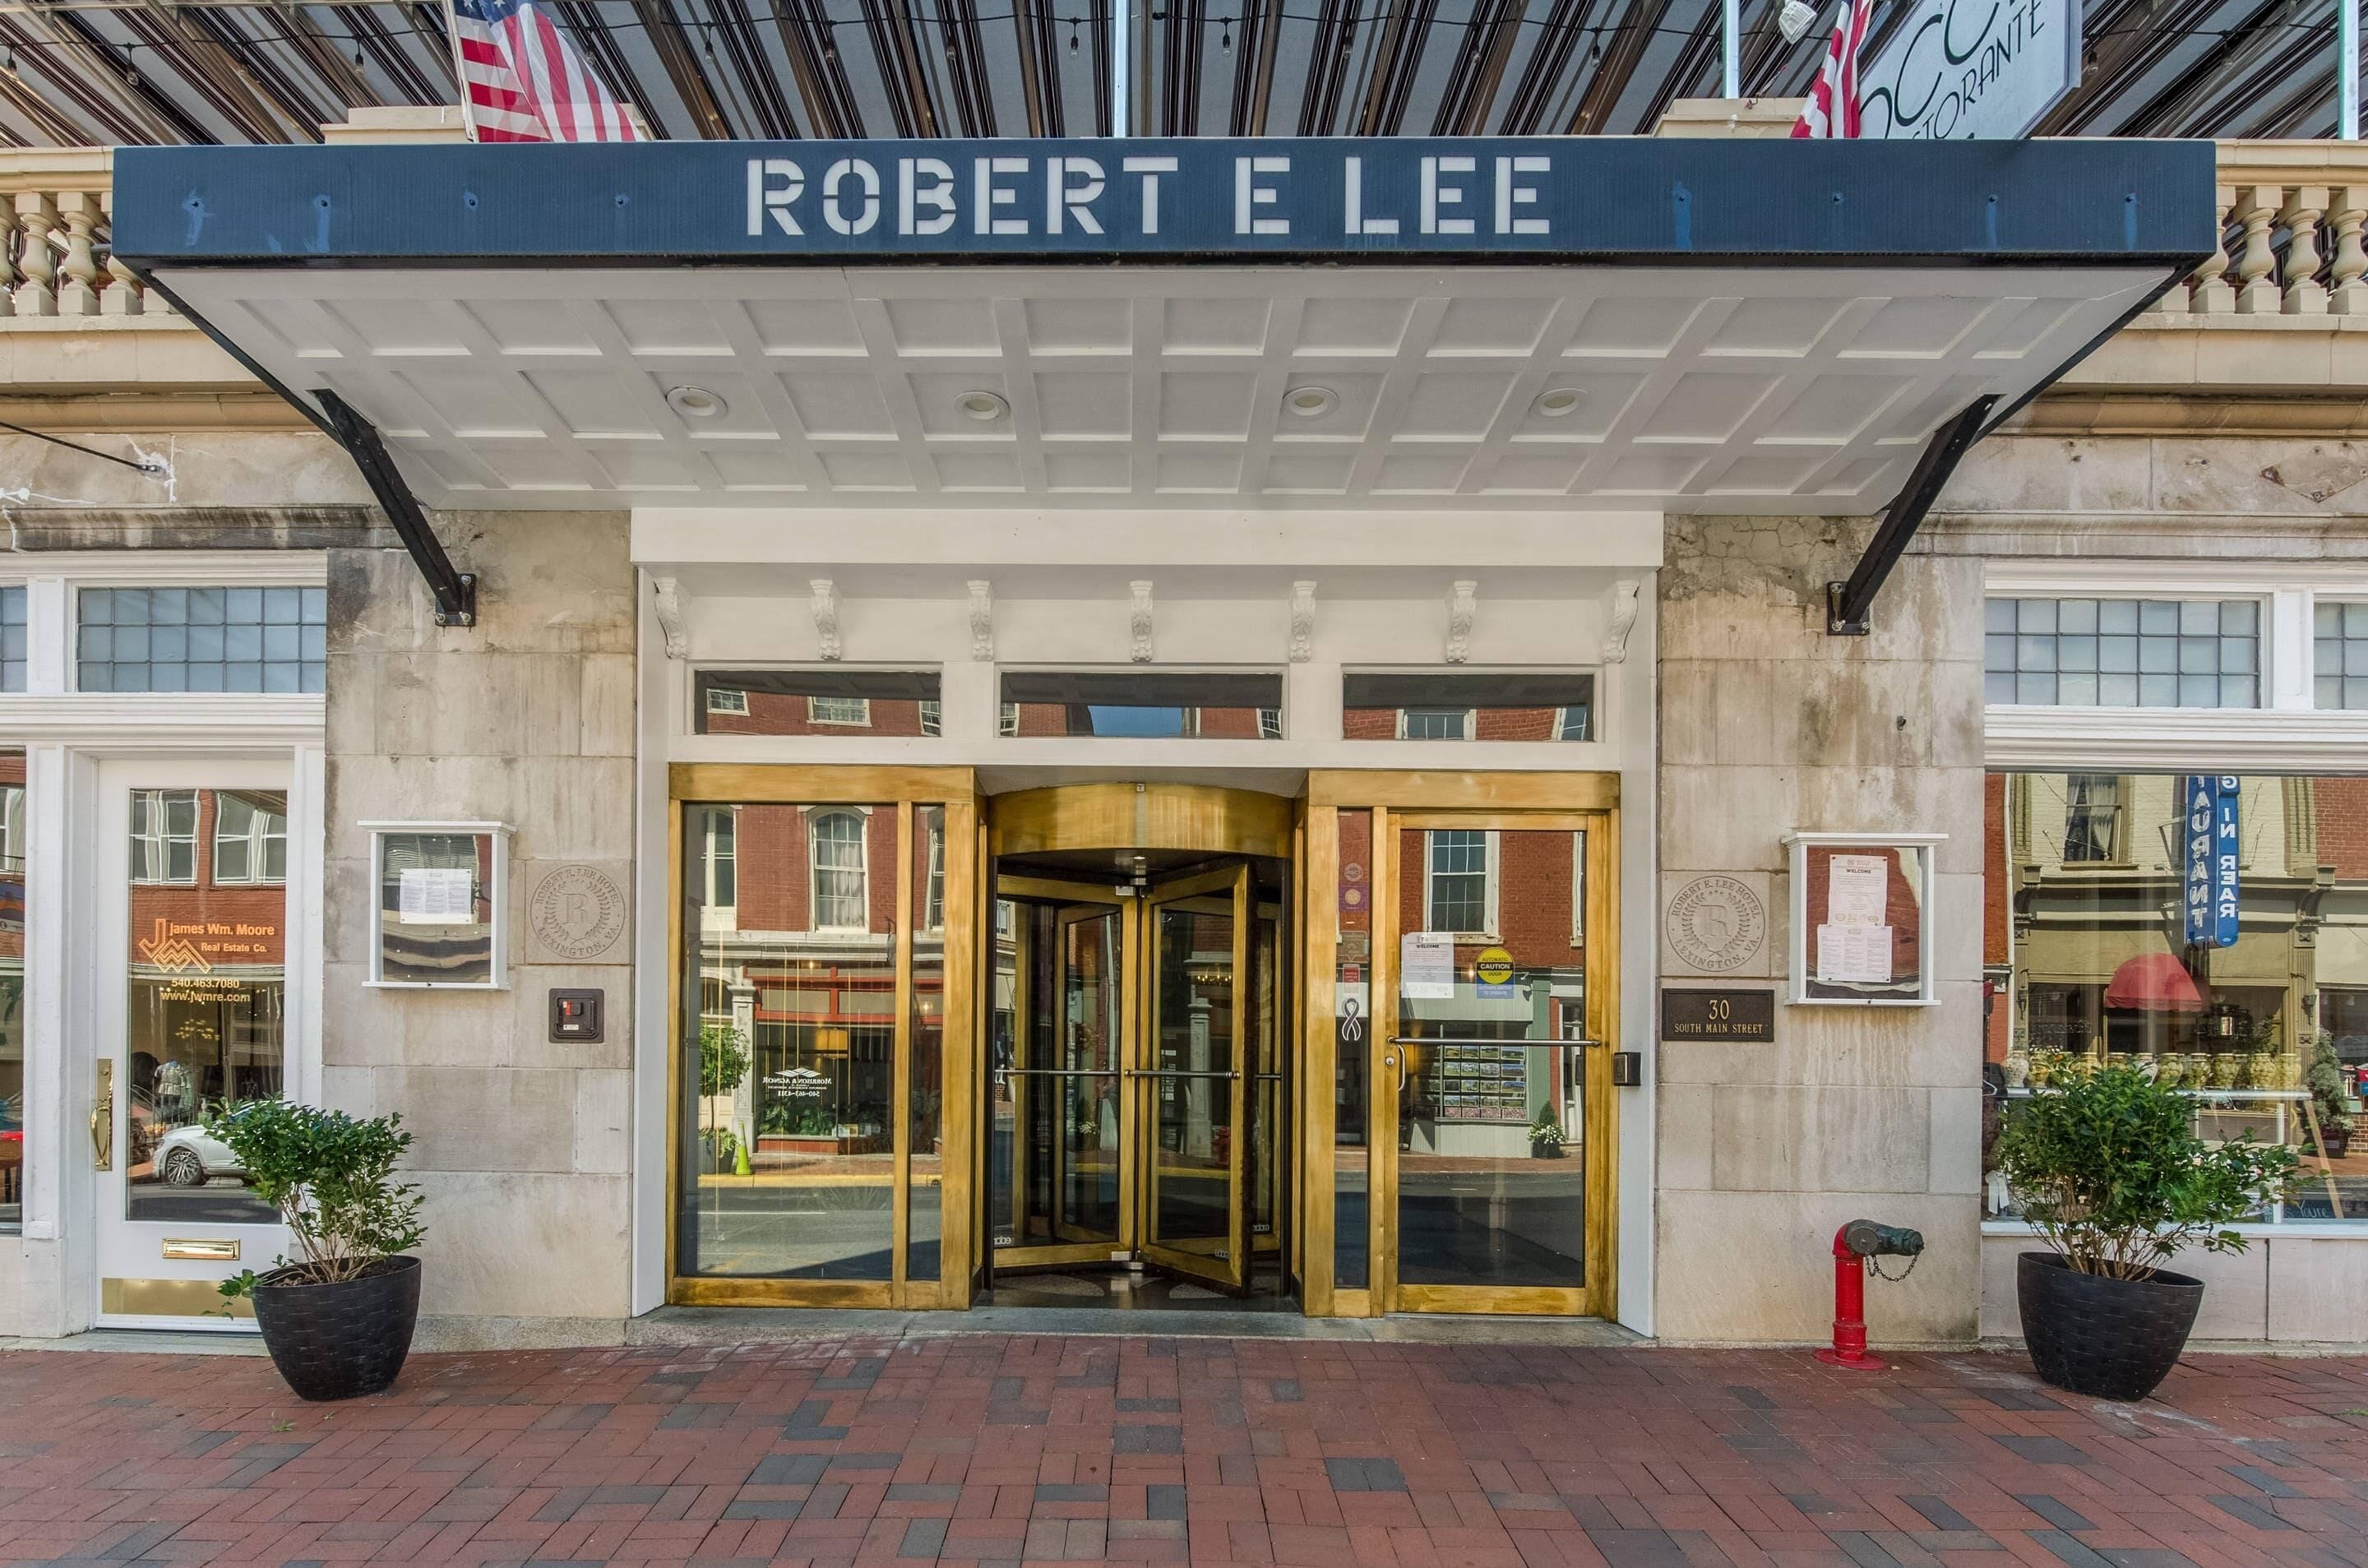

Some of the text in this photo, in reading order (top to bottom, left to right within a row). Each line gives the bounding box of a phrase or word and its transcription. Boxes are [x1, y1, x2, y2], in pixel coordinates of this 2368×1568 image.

[1912, 0, 2046, 138] TORANTE
[747, 156, 1552, 236] ROBERT E LEE
[596, 874, 620, 908] HOTEL
[1672, 882, 1701, 918] ROBERT
[1715, 879, 1736, 891] LEE
[1735, 887, 1762, 919] HOTEL
[169, 923, 275, 936] James Wm. Moore
[201, 942, 267, 953] Real Estate Co.
[1674, 938, 1746, 969] LEXINGTON,
[171, 978, 240, 988] 540.463.7080
[160, 991, 251, 1003] www.jwmre.com
[1708, 999, 1730, 1020] 30
[1674, 1023, 1763, 1034] SOUTH MAIN STREET
